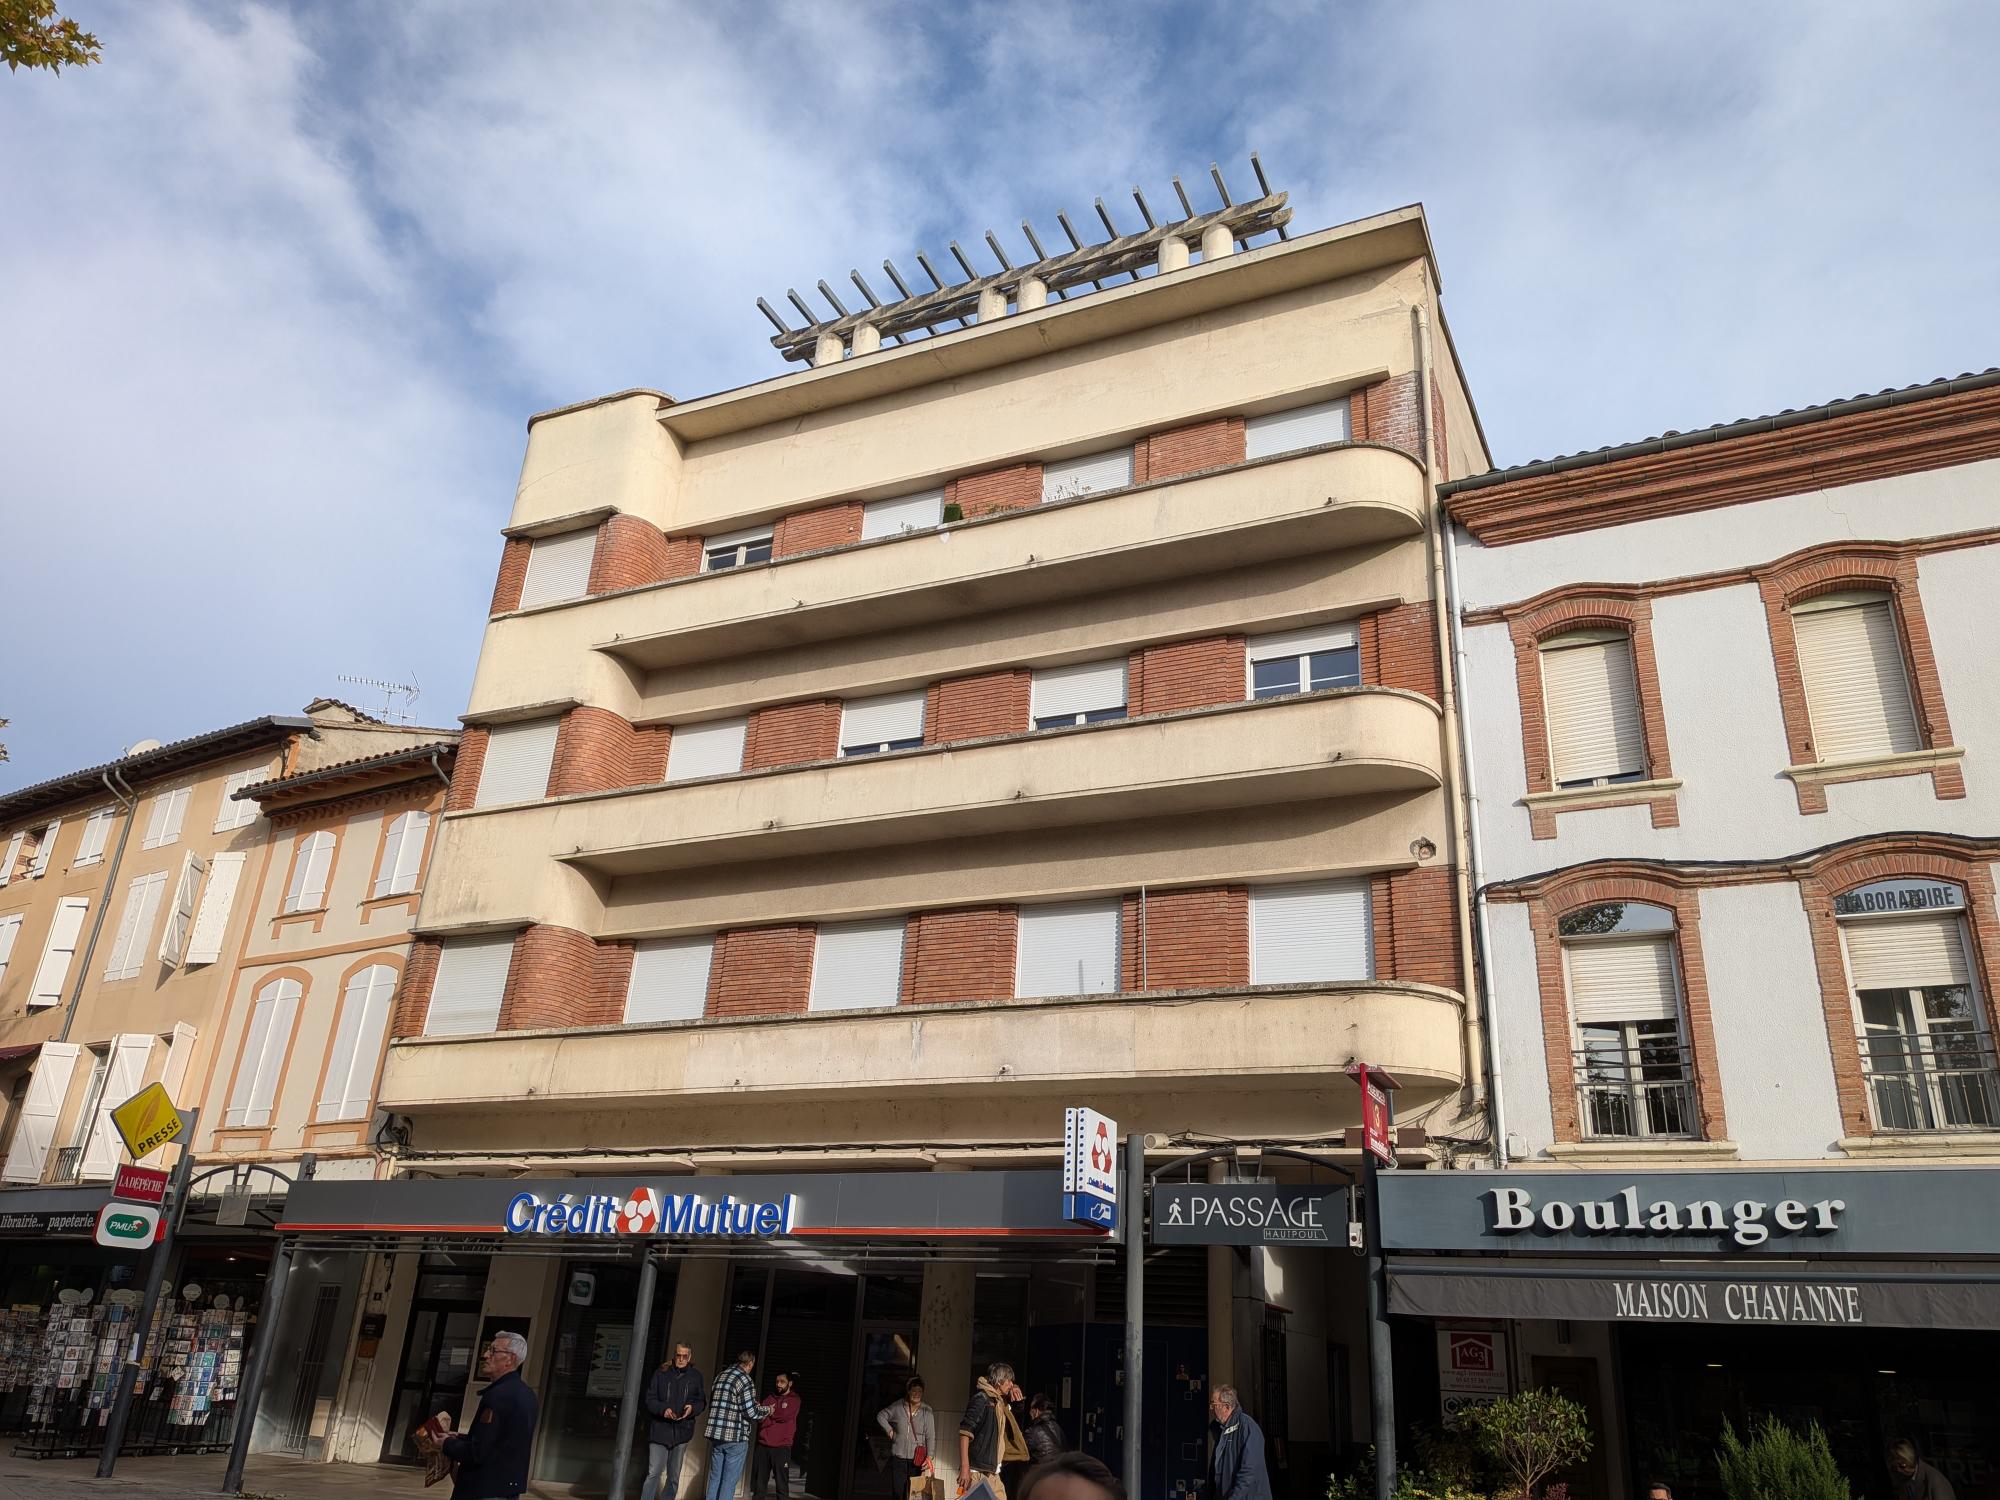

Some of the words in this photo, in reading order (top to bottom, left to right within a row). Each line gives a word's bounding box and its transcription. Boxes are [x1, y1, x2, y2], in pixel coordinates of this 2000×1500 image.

[137, 1117, 179, 1153] PRESSE
[118, 1175, 129, 1188] LA
[129, 1176, 164, 1193] DÉPÊCHE
[109, 1220, 132, 1232] PMU
[505, 1191, 622, 1234] Crédit
[659, 1192, 797, 1235] Mutuel
[1191, 1197, 1323, 1227] PASSAGE
[1488, 1185, 1848, 1246] Boulanger
[1612, 1282, 1709, 1320] MAISON
[1724, 1283, 1863, 1323] CHAVANNE
